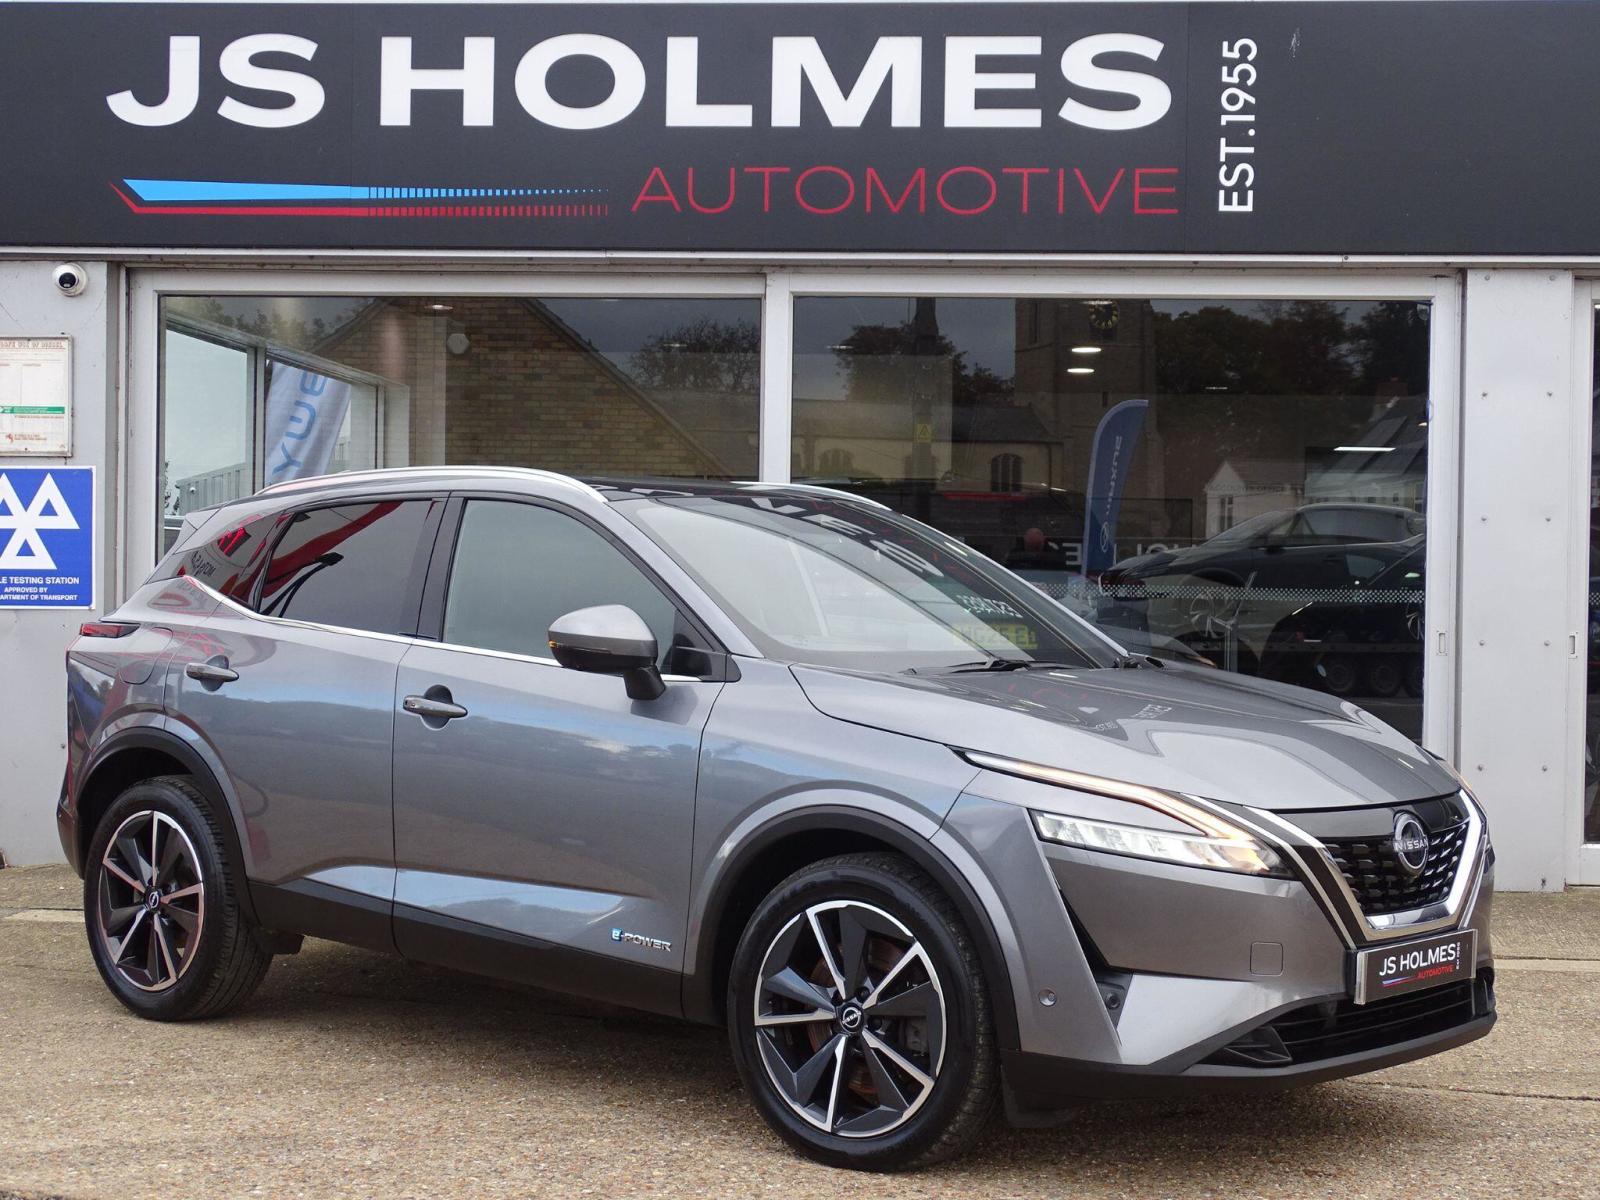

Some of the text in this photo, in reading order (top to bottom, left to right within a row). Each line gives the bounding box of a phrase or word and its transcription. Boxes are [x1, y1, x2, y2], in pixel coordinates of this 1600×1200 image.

[106, 32, 1172, 131] JS HOLMES
[1218, 38, 1258, 213] EST.1955
[630, 165, 1180, 216] AUTOMOTIVE
[9, 576, 43, 585] TESTING
[45, 576, 80, 585] STATION
[1394, 838, 1429, 852] NISSAN
[1379, 956, 1397, 976] JS
[1400, 943, 1456, 972] HOLMES
[1417, 964, 1455, 979] AUTOMOTIVE
